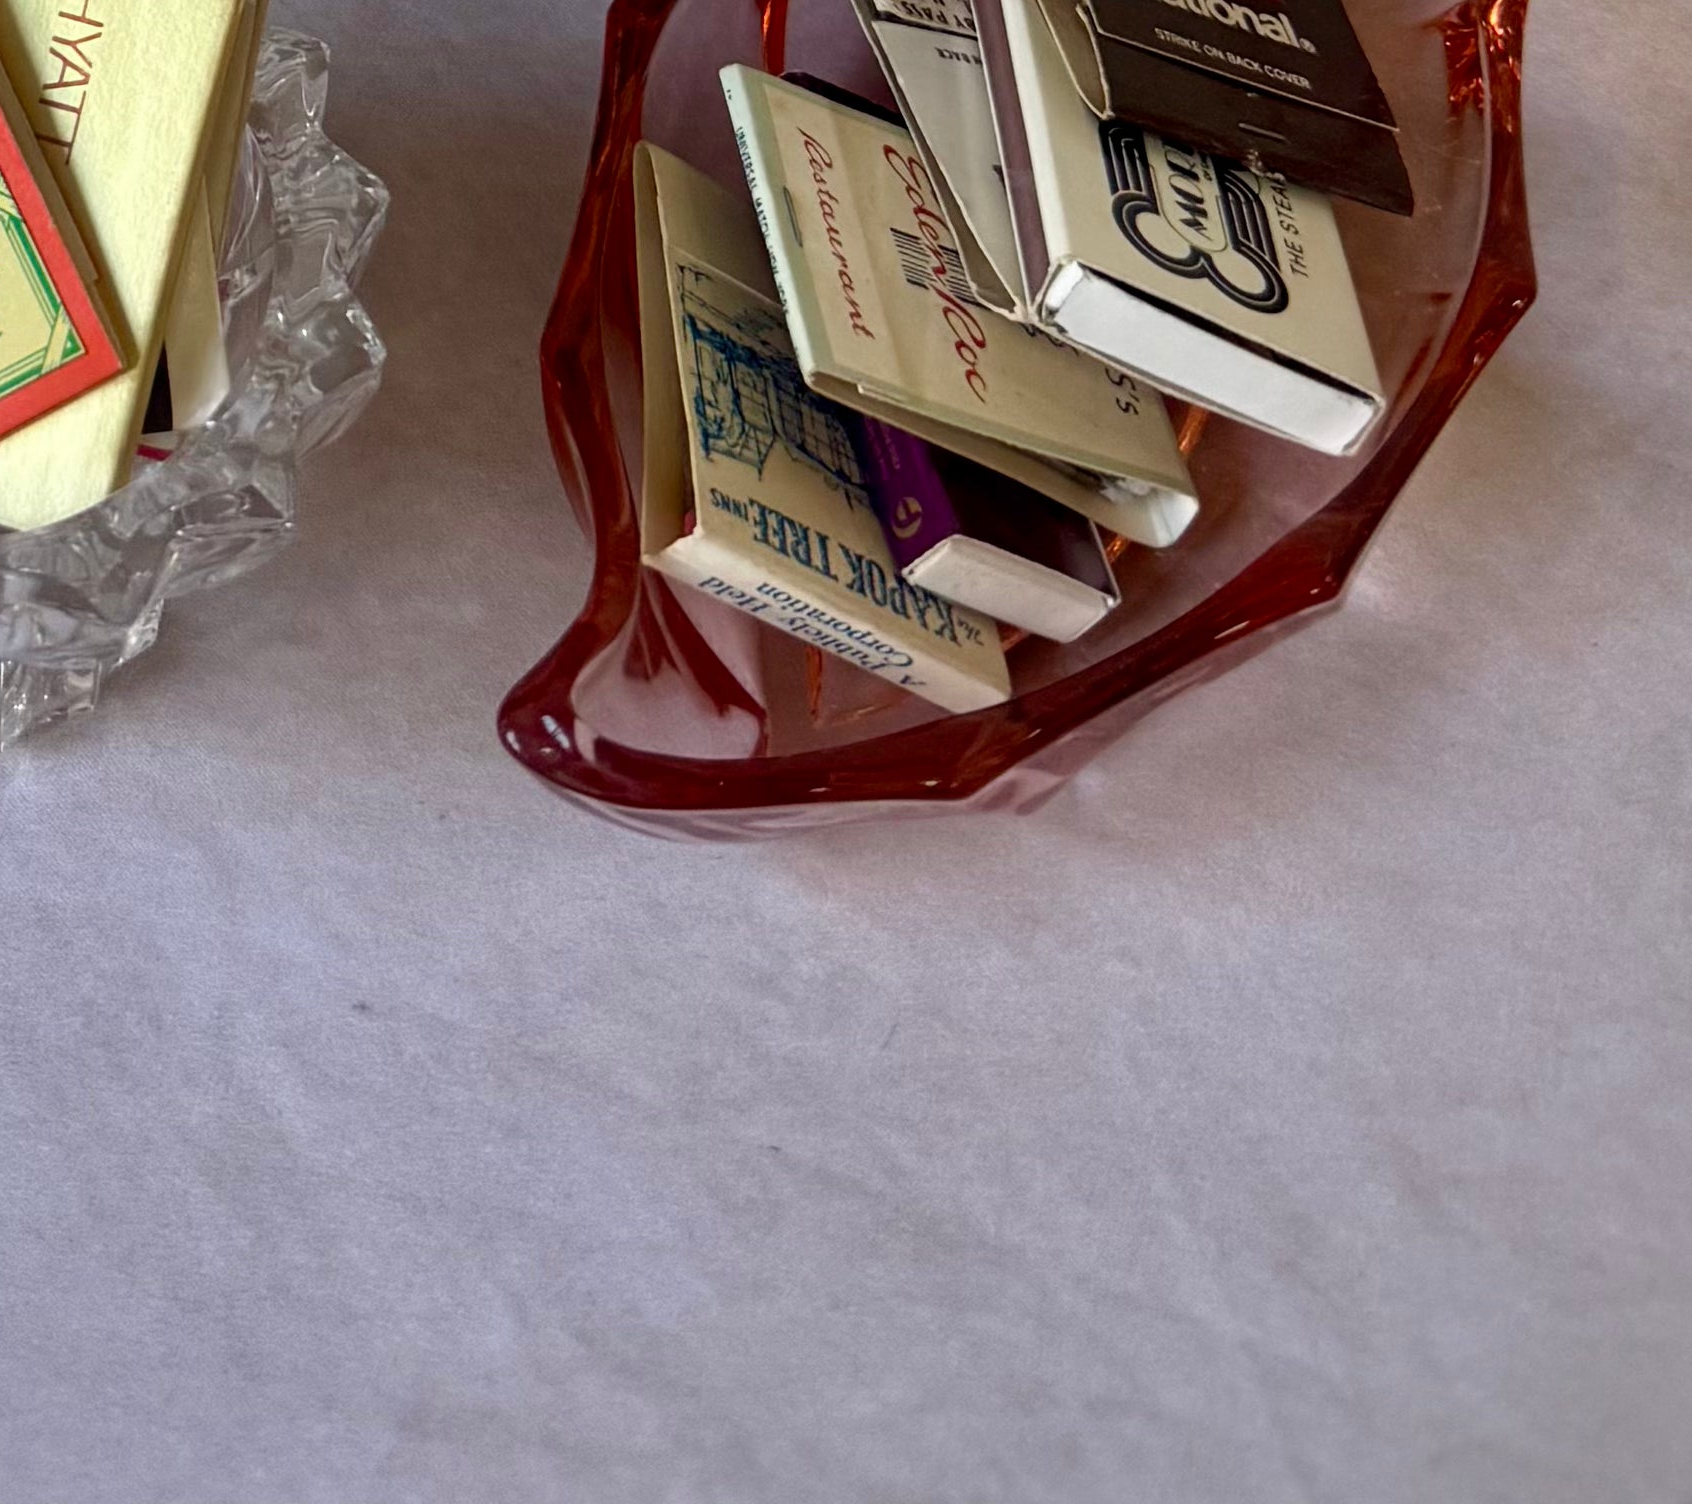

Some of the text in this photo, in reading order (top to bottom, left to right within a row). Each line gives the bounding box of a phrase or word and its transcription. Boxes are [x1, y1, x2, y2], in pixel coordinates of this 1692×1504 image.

[1153, 26, 1312, 89] STRIKE ON BACK COVER
[796, 126, 876, 340] Restaurant
[883, 144, 987, 404] Eden Roc
[1289, 242, 1309, 279] THE
[710, 487, 750, 523] INNS
[748, 497, 839, 582] TREE
[697, 576, 927, 687] A Publicly Held
[756, 581, 914, 668] Corporation
[838, 542, 963, 647] KAPOK
